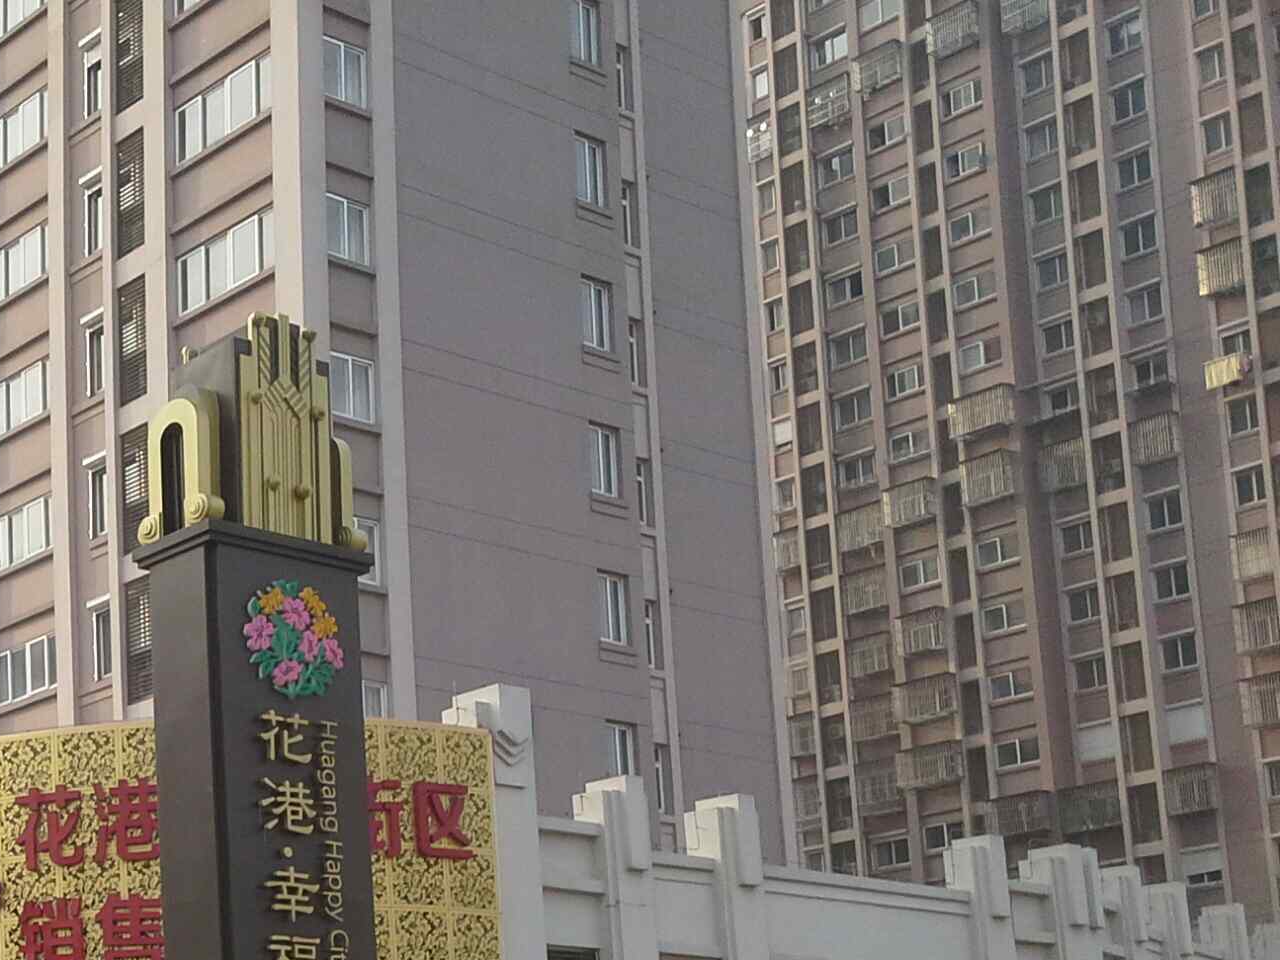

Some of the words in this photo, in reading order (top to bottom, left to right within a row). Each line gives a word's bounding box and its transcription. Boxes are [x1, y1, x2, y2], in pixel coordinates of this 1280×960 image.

[316, 719, 340, 833] Huagang
[15, 777, 160, 872] 花港
[322, 839, 345, 922] Happy
